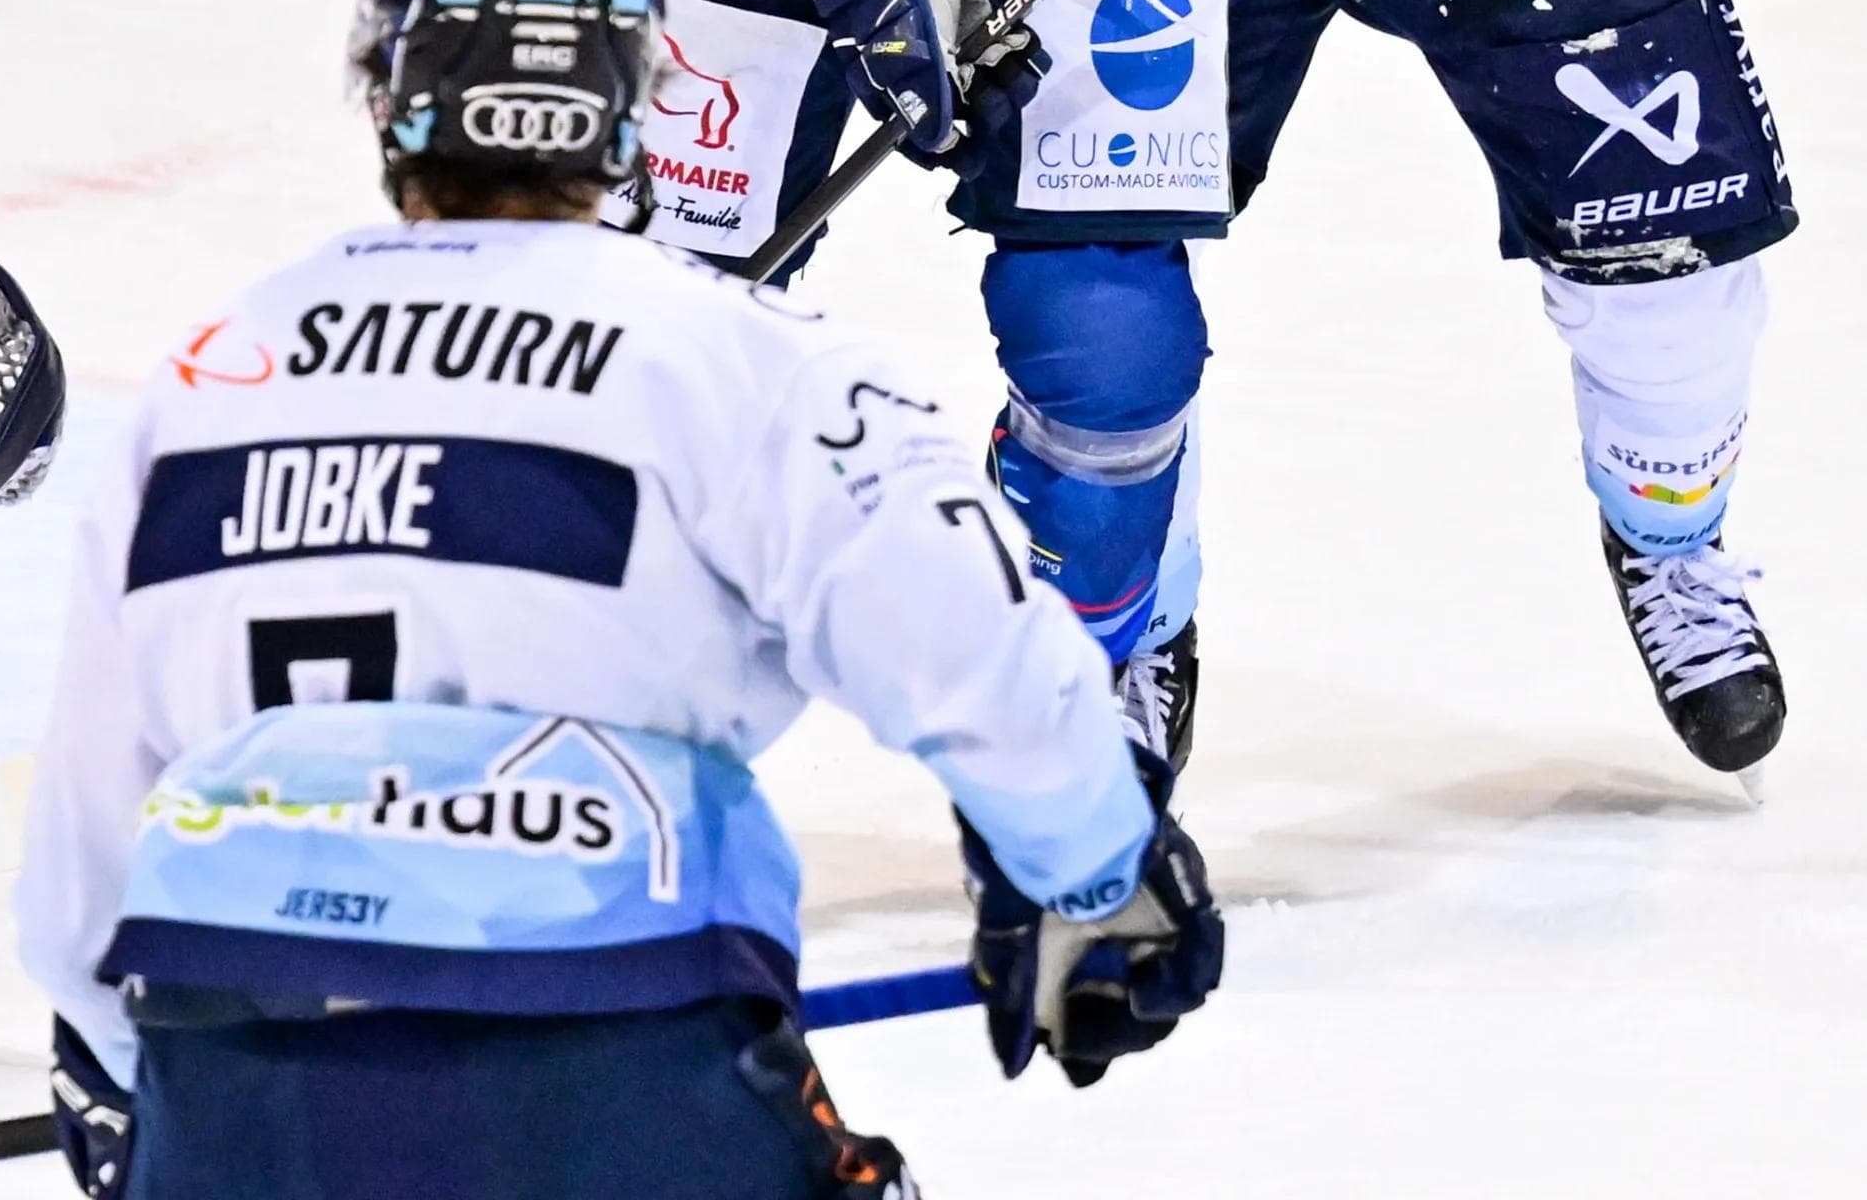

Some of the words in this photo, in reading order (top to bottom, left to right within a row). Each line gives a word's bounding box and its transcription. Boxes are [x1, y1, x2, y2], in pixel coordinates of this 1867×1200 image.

[1037, 173, 1164, 190] CUSTOM-MADE
[1168, 173, 1221, 190] AVIONICS
[286, 301, 624, 396] SATURN
[220, 443, 444, 558] JOBKE
